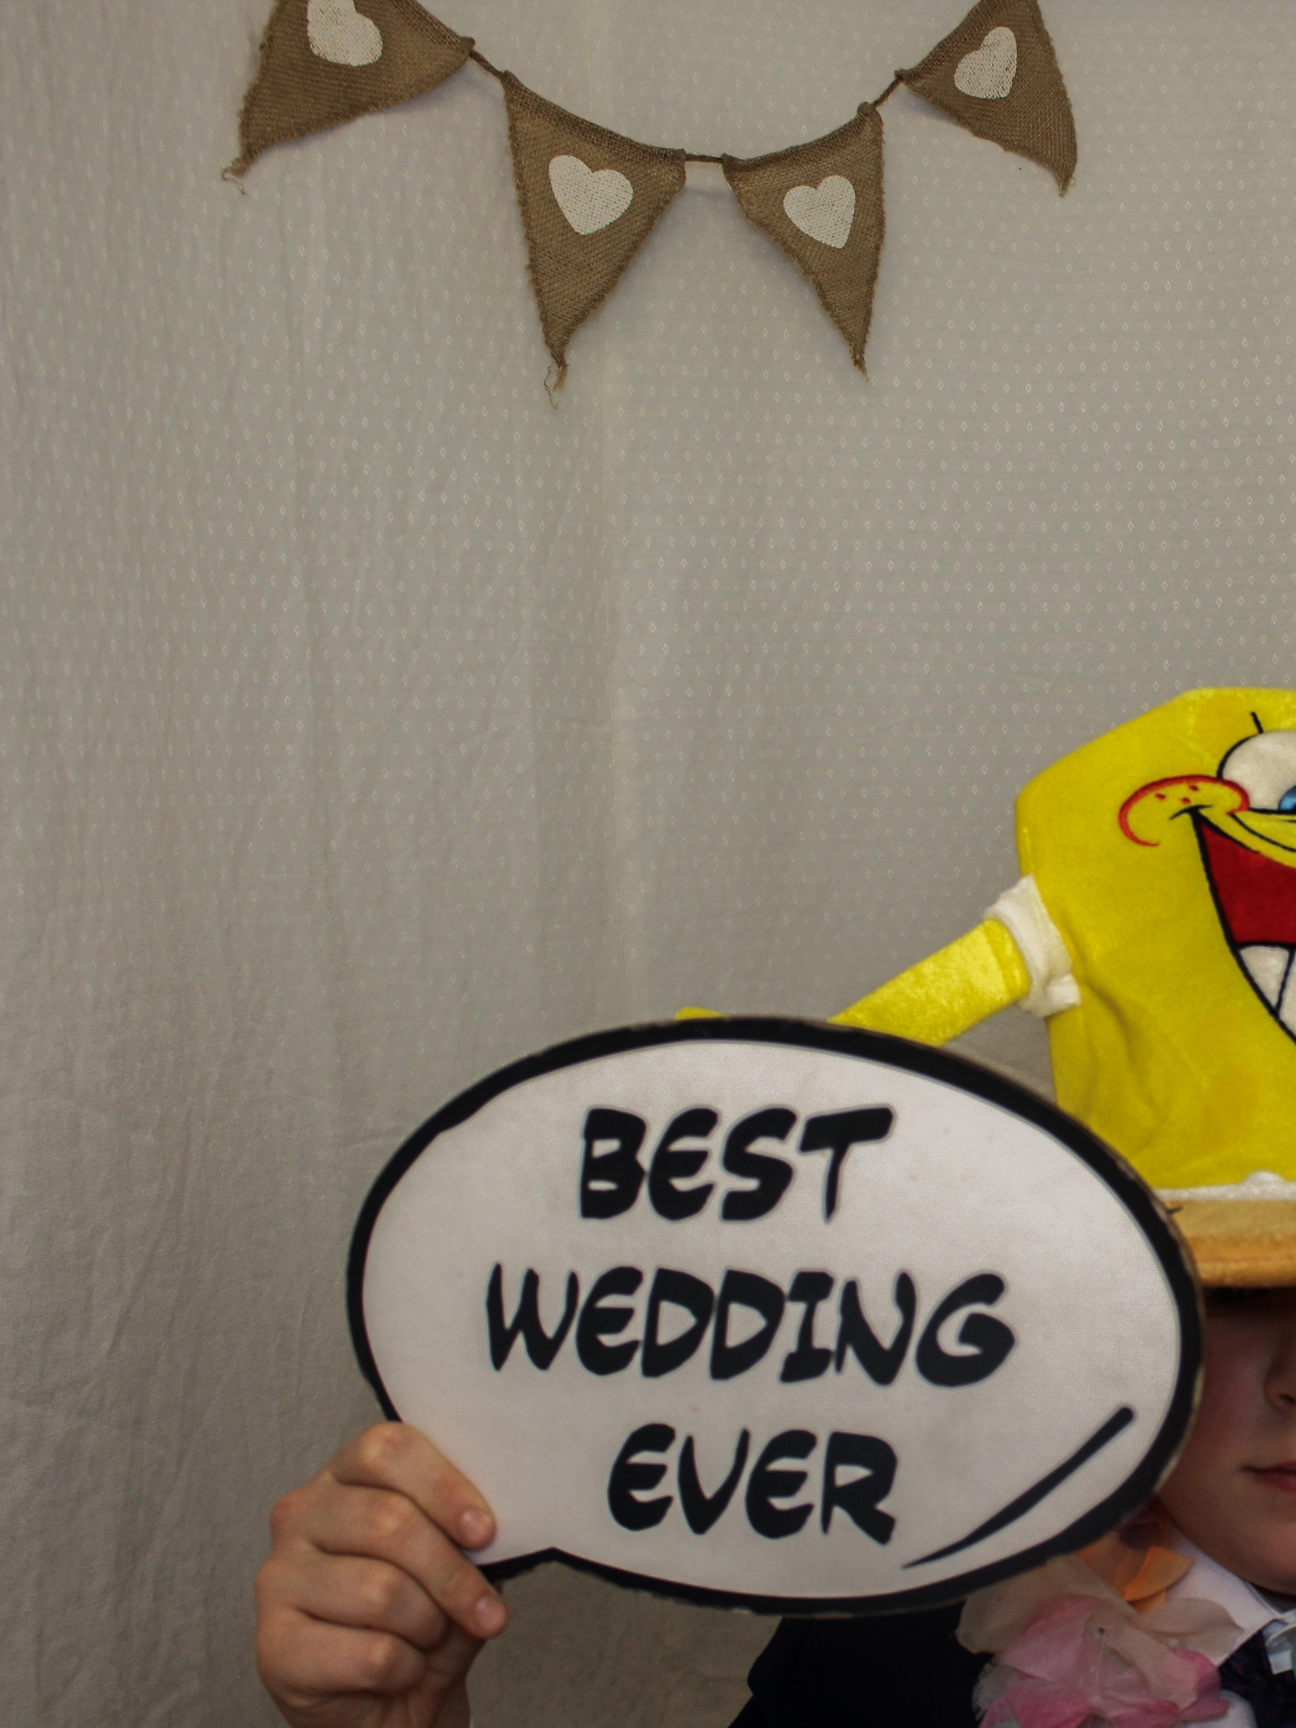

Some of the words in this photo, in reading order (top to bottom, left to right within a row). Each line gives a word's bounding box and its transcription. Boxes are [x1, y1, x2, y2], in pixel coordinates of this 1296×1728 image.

[579, 1106, 895, 1223] BEST
[485, 1262, 1016, 1388] WEDDING
[606, 1422, 899, 1546] EVER
